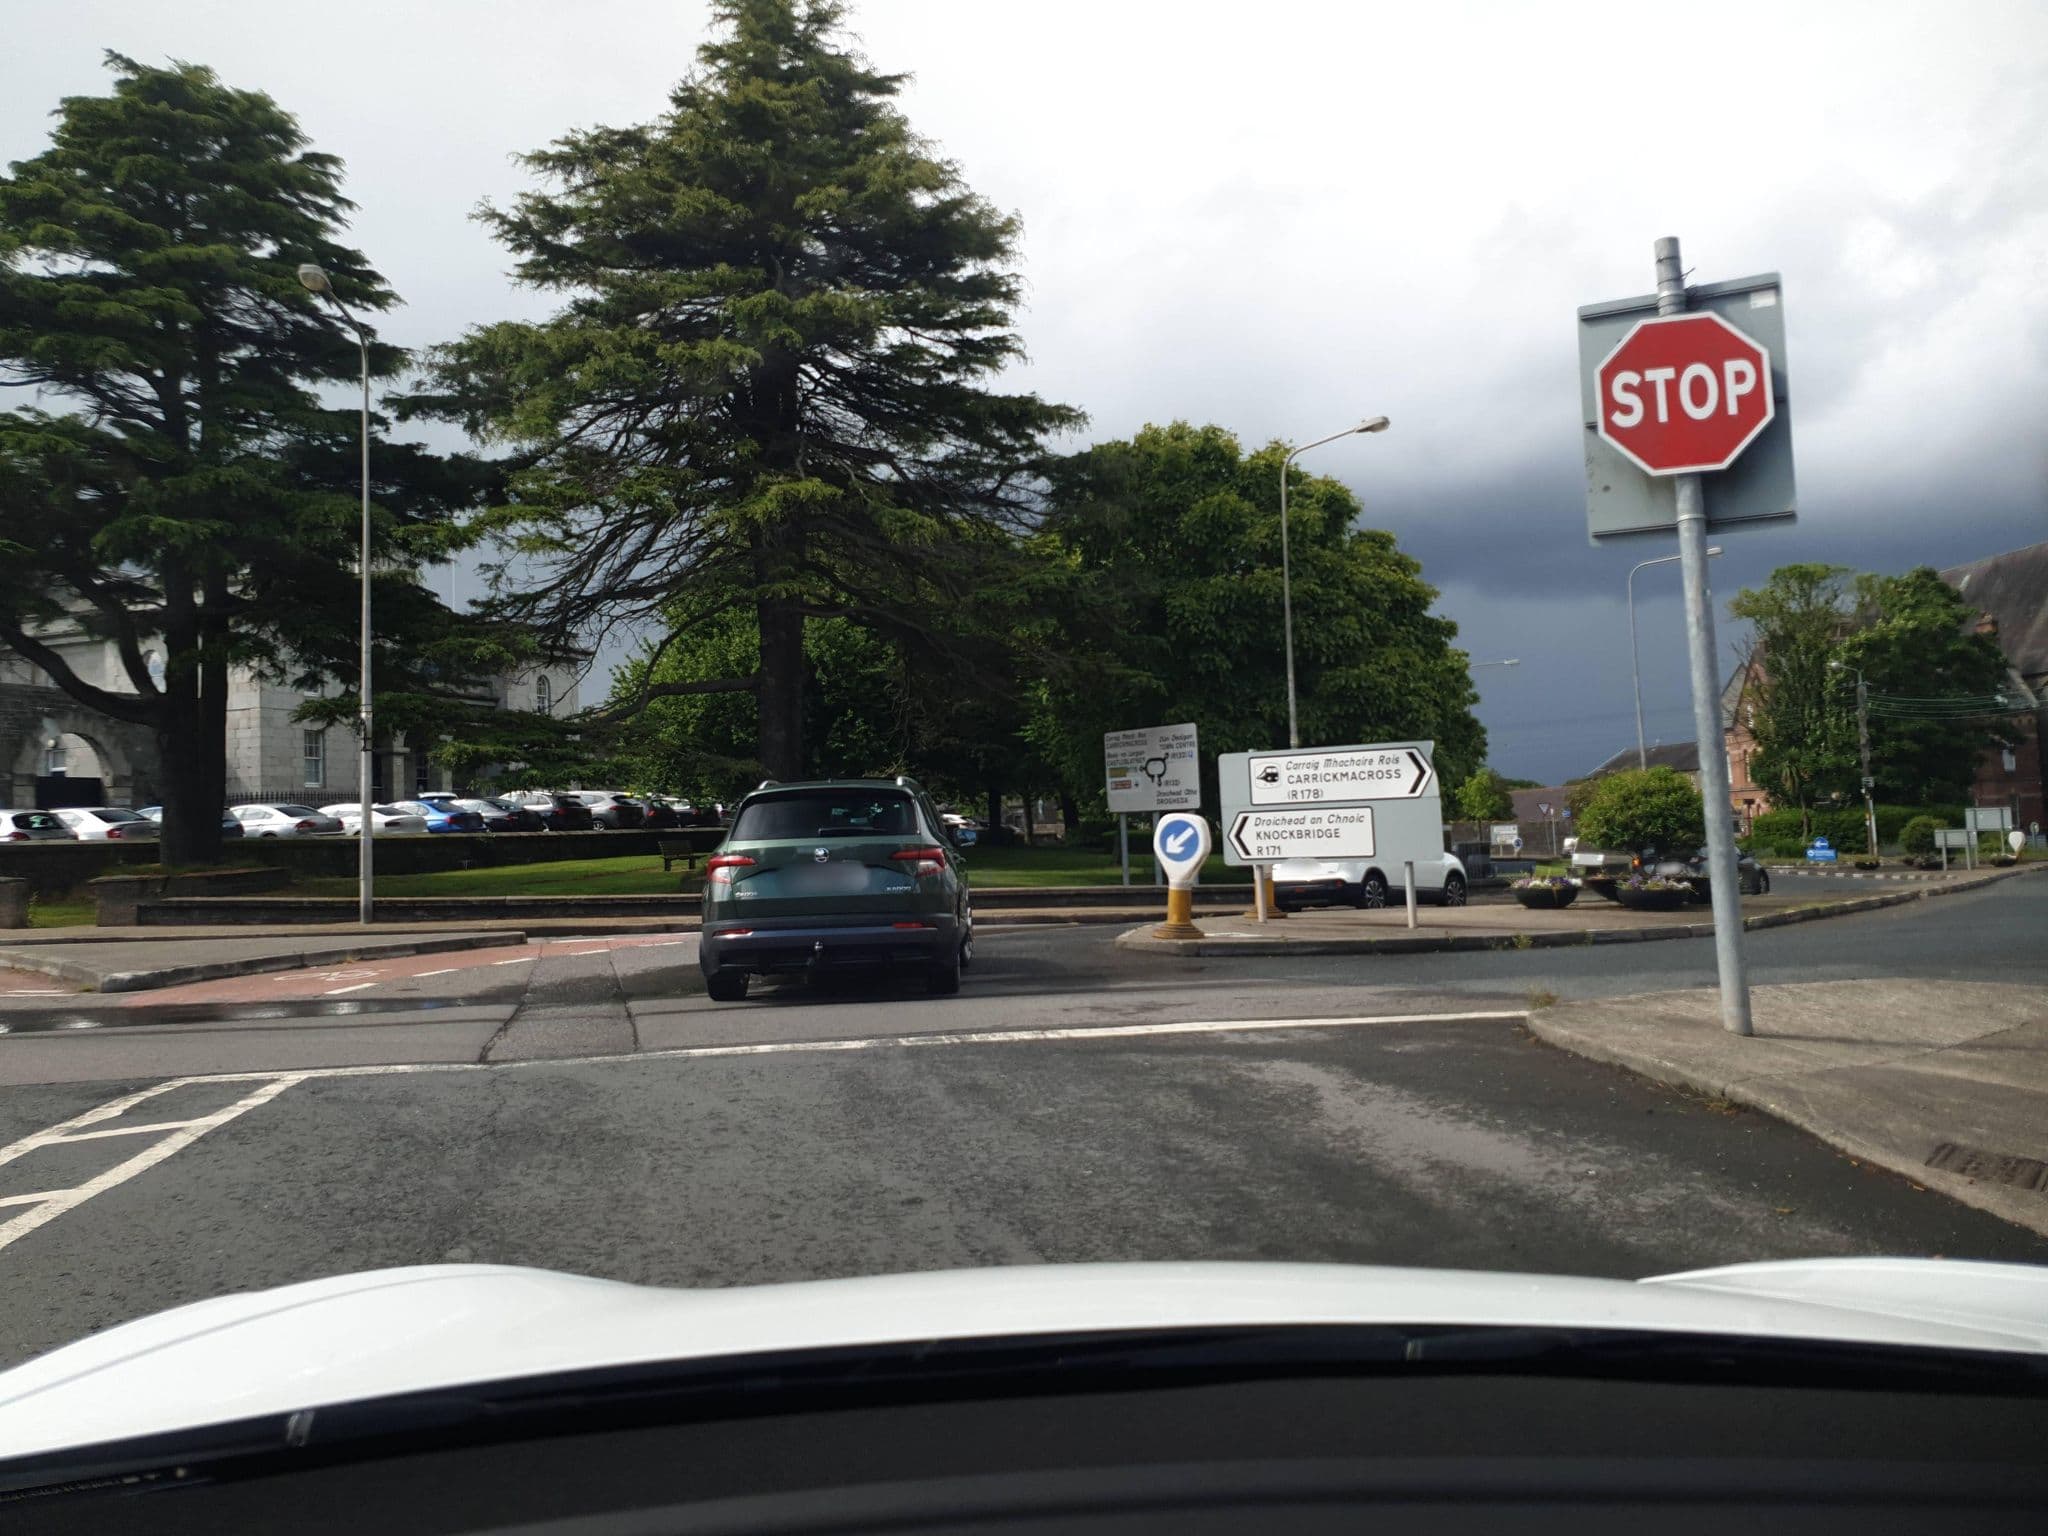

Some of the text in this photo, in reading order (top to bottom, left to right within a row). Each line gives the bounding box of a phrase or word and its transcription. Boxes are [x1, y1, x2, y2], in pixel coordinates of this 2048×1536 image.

[1611, 359, 1756, 428] STOP
[1286, 760, 1319, 771] Carraig
[1323, 757, 1374, 769] Mhachaire
[1286, 768, 1402, 785] CARRICKMACROSS
[1254, 813, 1365, 827] Droichead an Chnoic
[1255, 828, 1341, 841] KNOCKBRIDGE
